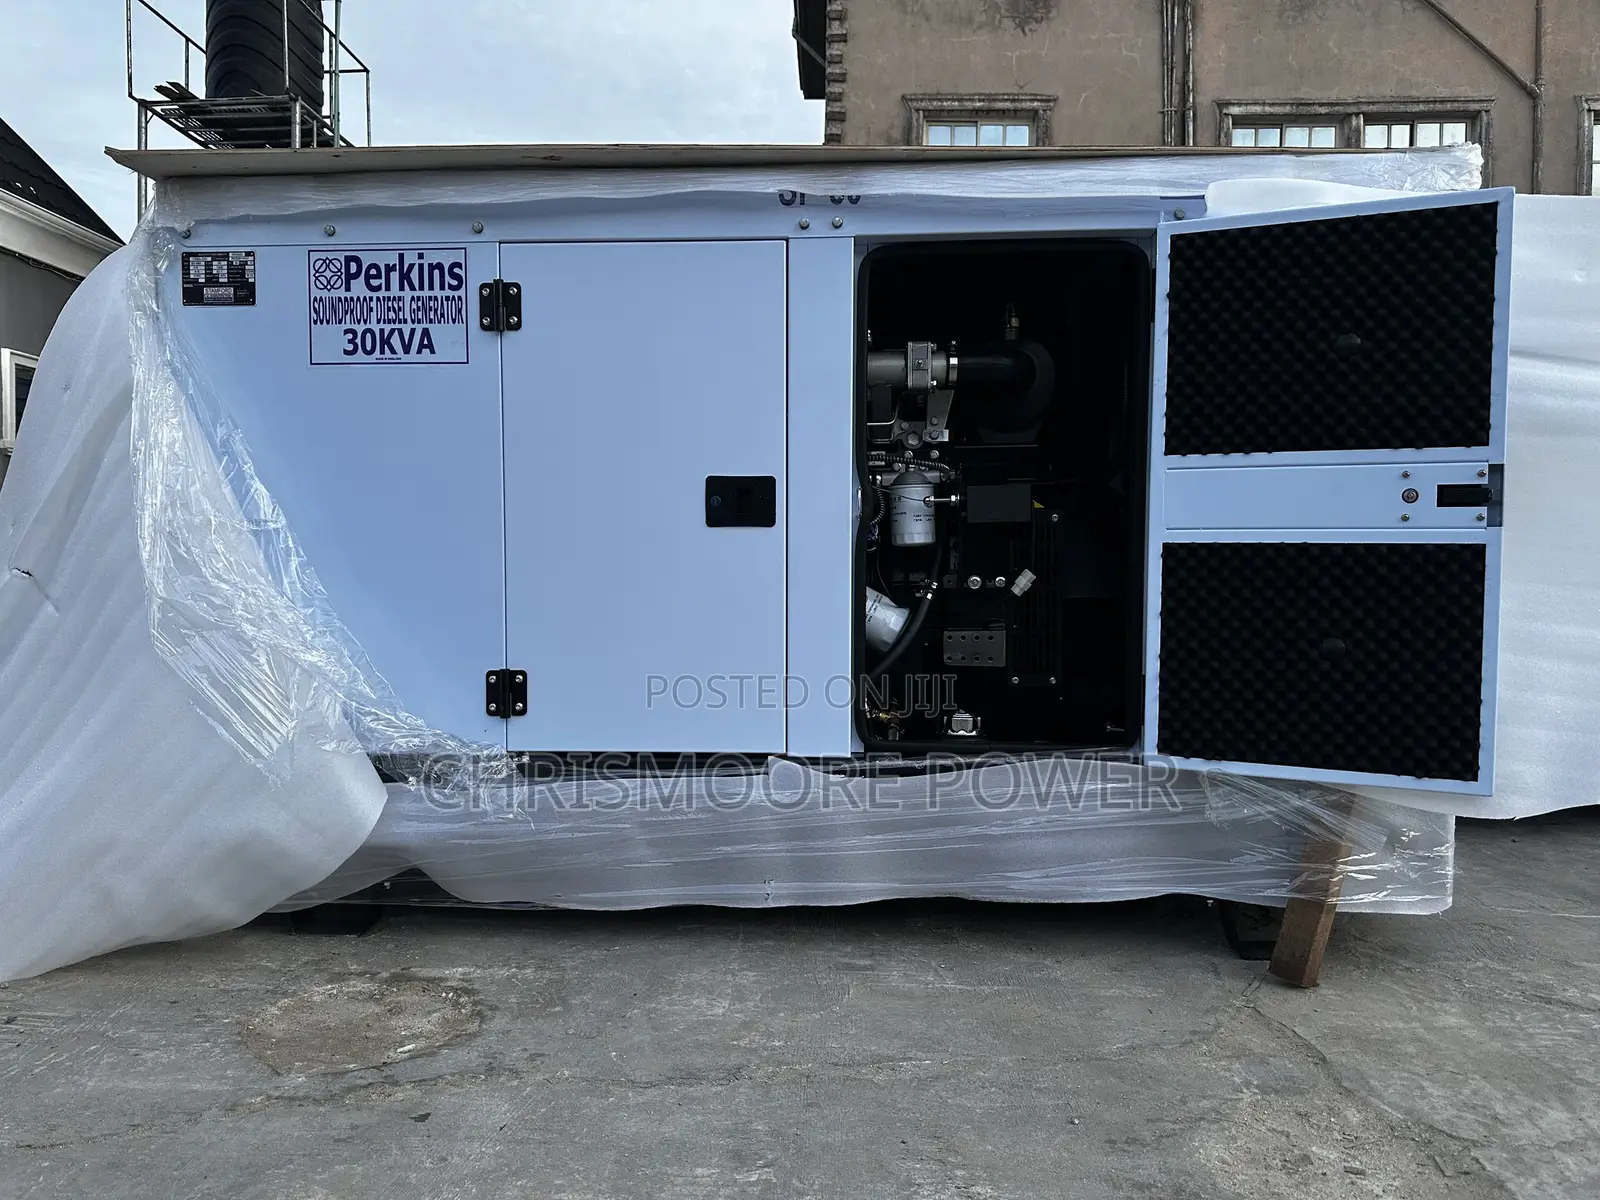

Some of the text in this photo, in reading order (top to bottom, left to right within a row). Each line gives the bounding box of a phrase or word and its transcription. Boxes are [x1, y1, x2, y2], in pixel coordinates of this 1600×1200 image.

[344, 252, 464, 292] Perkins
[312, 295, 464, 325] SOUNDPROOF DIESEL GENERATOR
[343, 327, 436, 356] 30KVA
